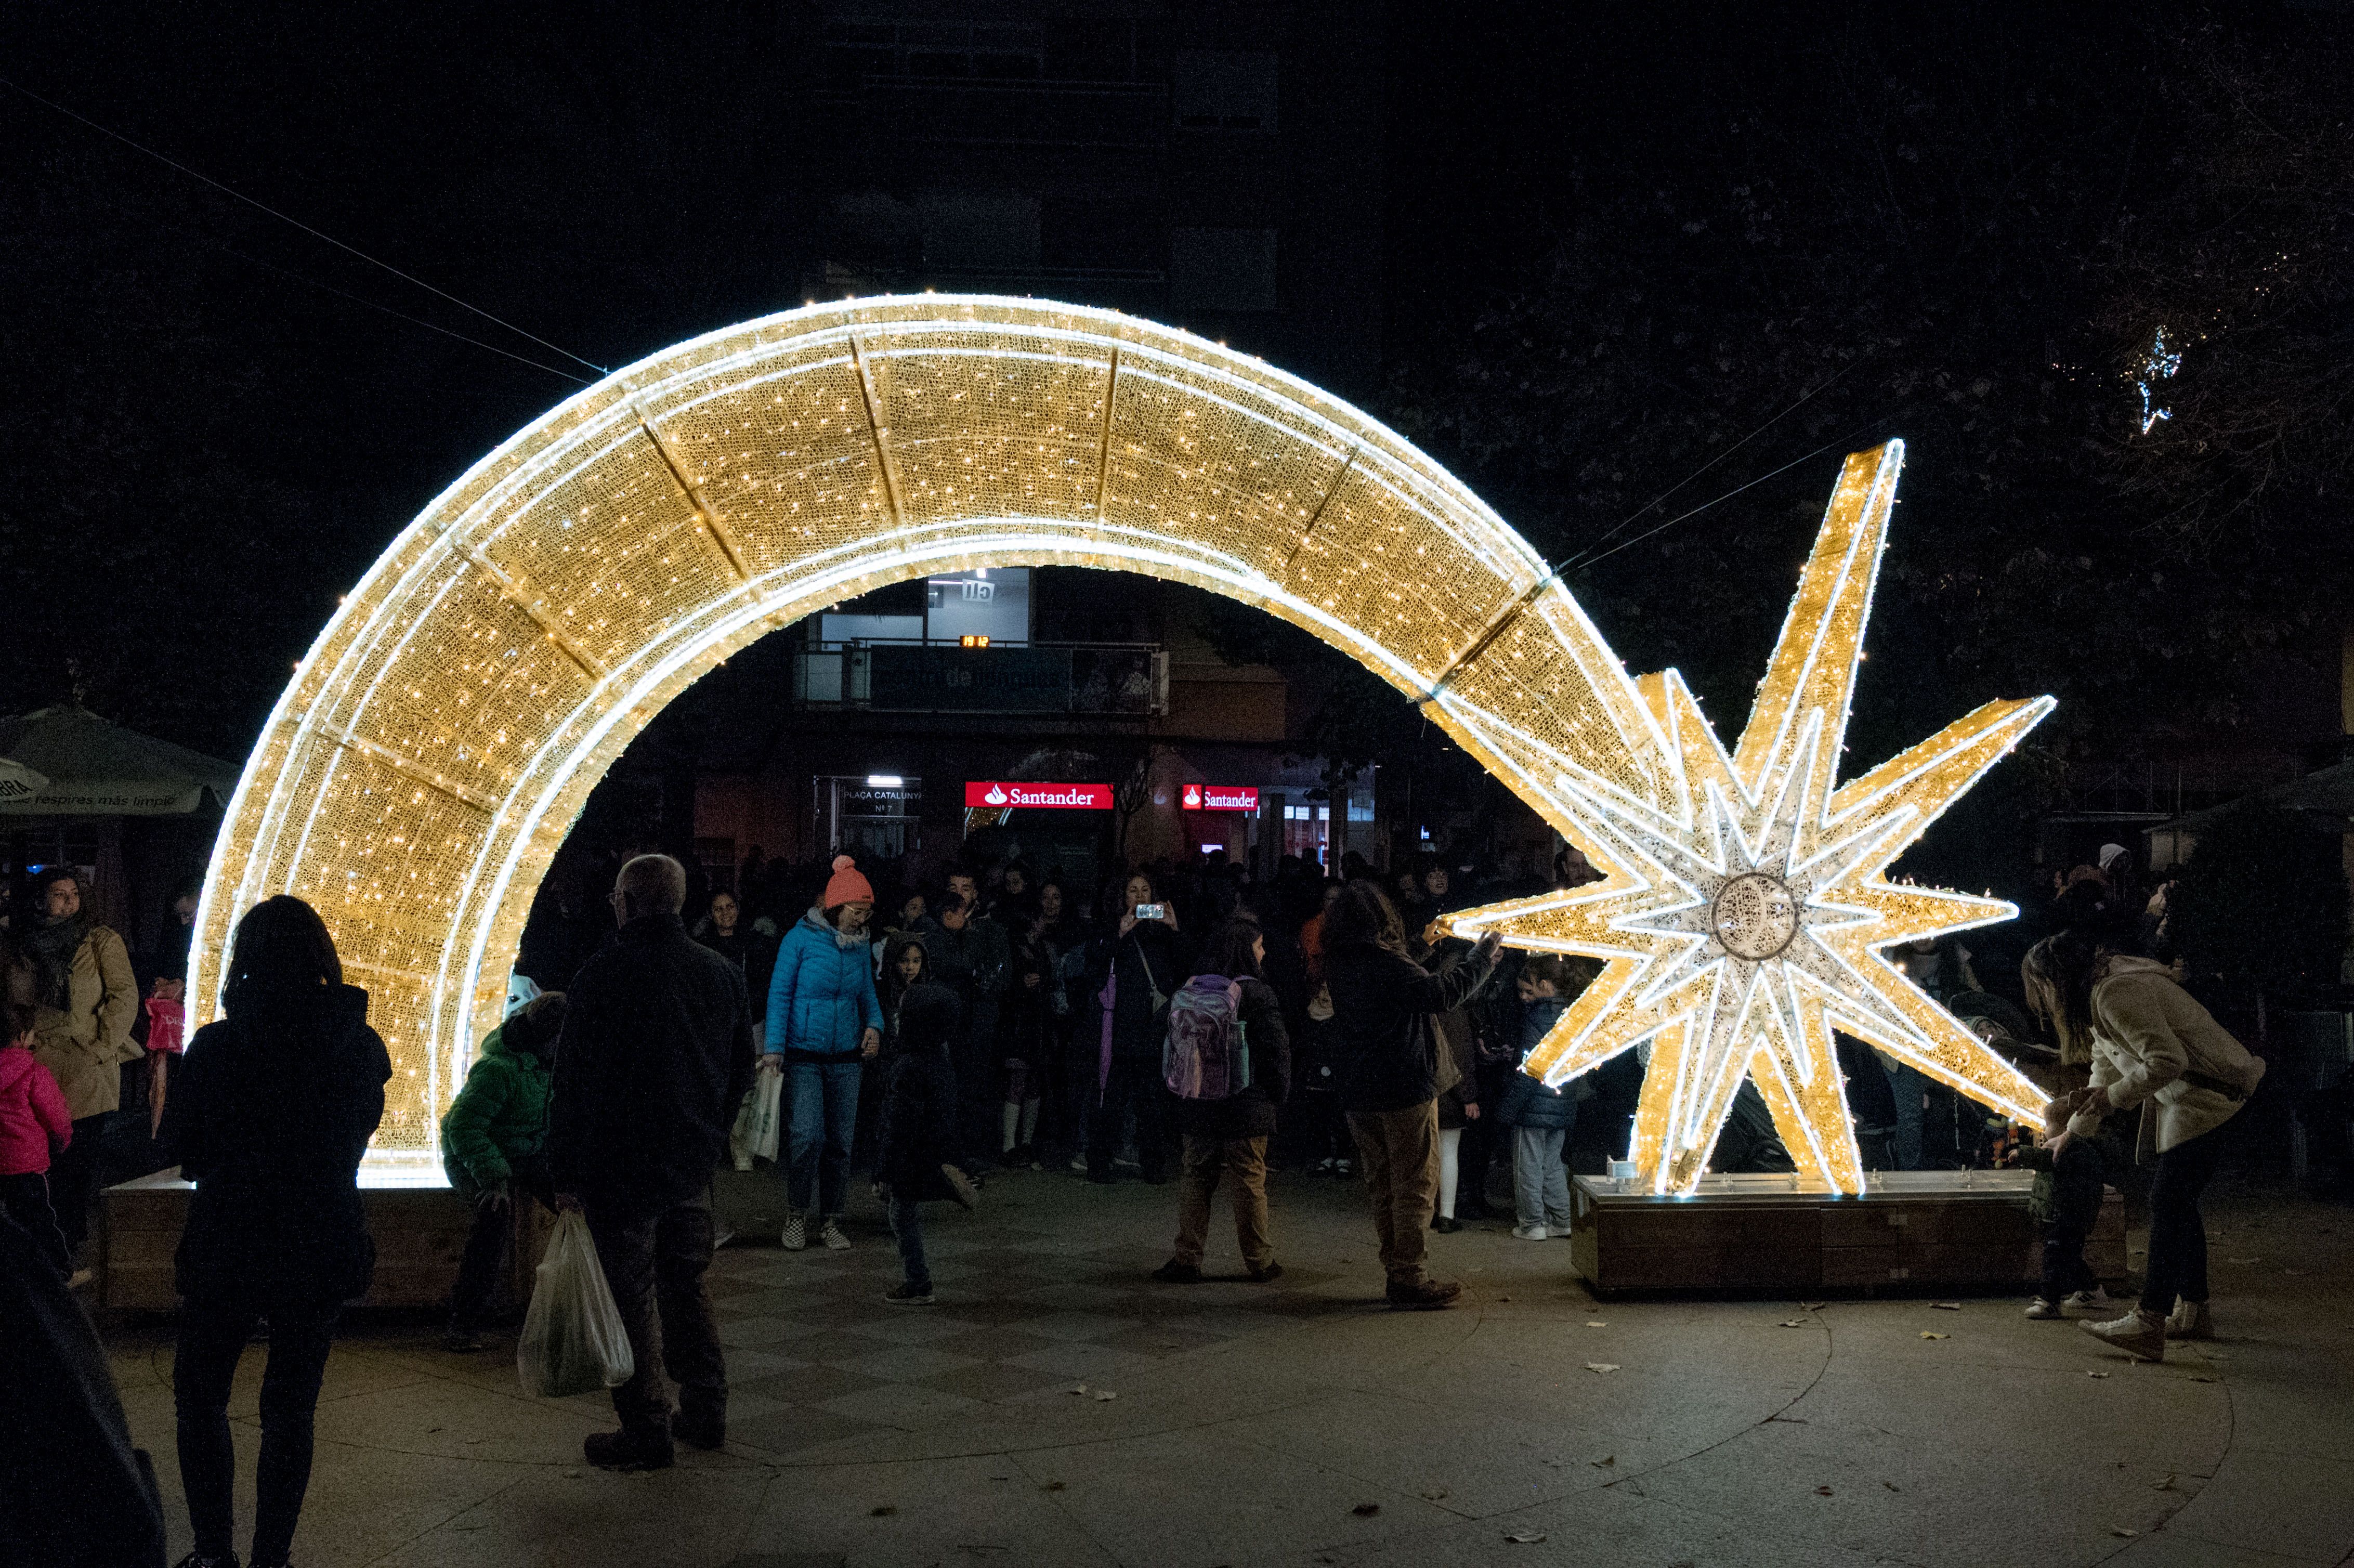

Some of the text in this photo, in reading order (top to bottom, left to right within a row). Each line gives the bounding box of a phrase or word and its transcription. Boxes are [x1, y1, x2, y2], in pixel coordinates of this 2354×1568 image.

[0, 780, 33, 796] BRA
[844, 791, 872, 800] PLAÇA
[35, 796, 93, 806] respires
[98, 792, 128, 806] más
[133, 795, 175, 807] limpio
[1010, 788, 1094, 805] Santander
[1205, 791, 1256, 807] Santander
